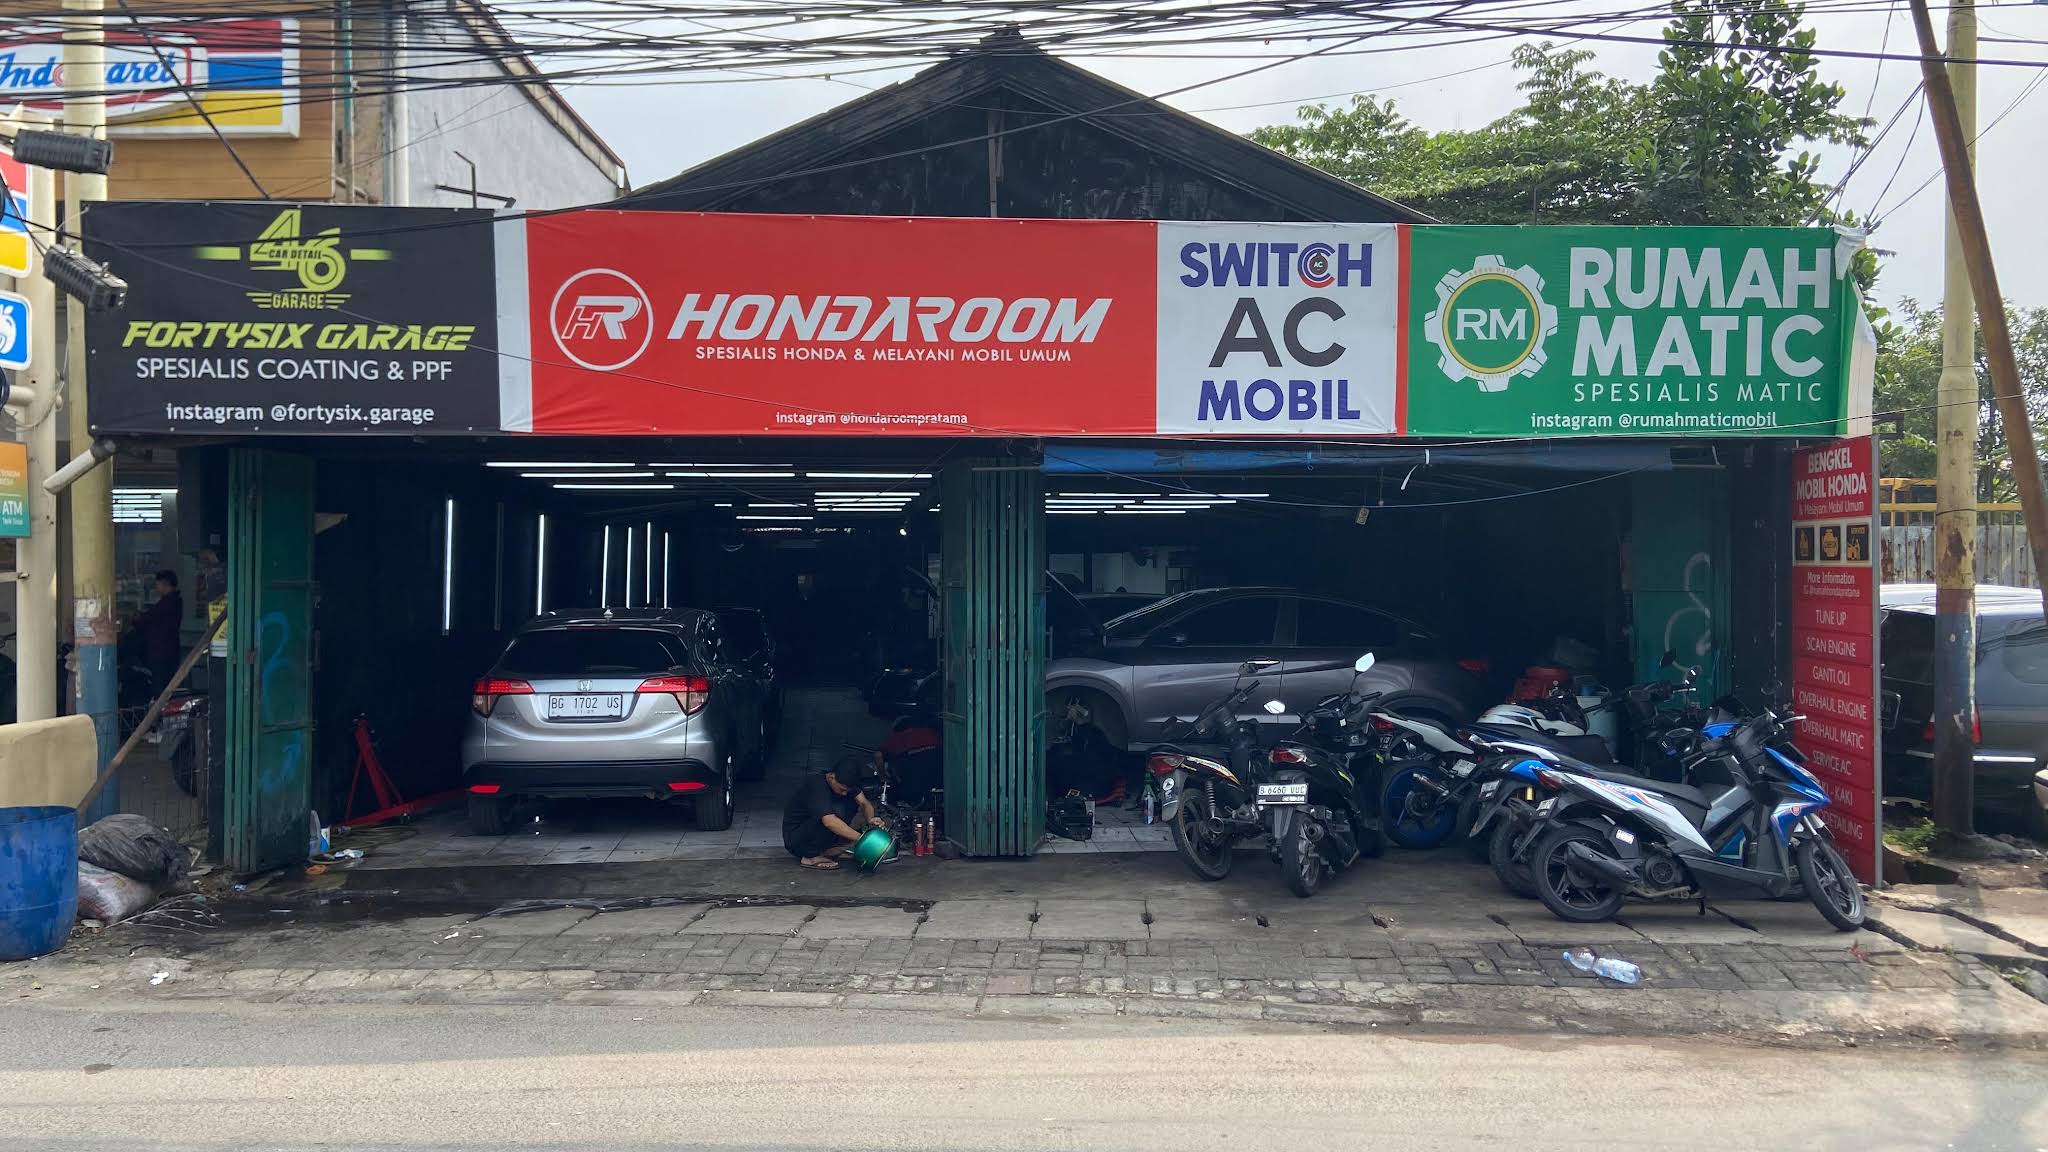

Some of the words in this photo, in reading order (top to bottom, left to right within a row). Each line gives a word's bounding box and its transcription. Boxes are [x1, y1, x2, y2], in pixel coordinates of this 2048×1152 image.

[0, 52, 176, 87] Indaret
[269, 250, 288, 259] CAR
[291, 250, 322, 259] DETAIL
[1180, 242, 1373, 288] SWITCH
[1569, 247, 1831, 309] RUMAH
[272, 294, 324, 309] GARAGE
[561, 296, 642, 340] HR
[667, 294, 1113, 343] HONDAROOM
[1455, 308, 1527, 341] RM
[122, 321, 314, 350] FORTYSIX
[316, 323, 475, 351] GARAGE
[1208, 296, 1347, 368] AC
[696, 347, 777, 360] SPESIALIS
[784, 347, 847, 361] HONDA
[853, 348, 866, 361] &
[873, 348, 955, 361] MELAYANI
[962, 349, 1013, 362] MOBIL
[1020, 349, 1071, 362] UMUM
[1571, 314, 1826, 378] MATIC
[136, 358, 249, 379] SPESIALIS
[258, 359, 379, 380] COATING
[387, 361, 404, 380] &
[412, 361, 452, 381] PPF
[1197, 378, 1361, 421] MOBIL
[1574, 383, 1719, 402] SPESIALIS
[1737, 382, 1822, 402] MATIC
[166, 403, 263, 424] instagram
[271, 404, 434, 425] @fortysix.garage
[776, 412, 836, 425] instagram
[840, 412, 968, 425] @hondaroompratama
[1531, 412, 1612, 430] instagram
[1618, 412, 1777, 429] @rumahmaticmobil
[1808, 447, 1852, 474] BENGKEL
[1797, 477, 1827, 501] MOBIL
[1828, 471, 1867, 498] HONDA
[2, 500, 23, 515] ATM
[1828, 501, 1843, 514] Mobil
[1844, 500, 1865, 513] Umum
[1808, 571, 1821, 584] More
[1822, 571, 1855, 585] Information
[1816, 610, 1835, 625] TUNE
[1837, 611, 1847, 625] UP
[1807, 637, 1827, 653] SCAN
[1828, 640, 1857, 658] ENGINE
[1813, 665, 1835, 682] GANTI
[1838, 670, 1850, 686] OLI
[551, 696, 564, 710] BG
[574, 697, 598, 709] 1702
[606, 697, 619, 709] US
[1799, 691, 1837, 713] OVERHAUL
[1838, 700, 1867, 720] ENGINE
[1801, 720, 1839, 742] OVERHAUL
[1840, 729, 1864, 750] MATIC
[1812, 750, 1840, 772] SERVICE
[1841, 760, 1852, 776] AC
[1835, 786, 1853, 806] KAKI
